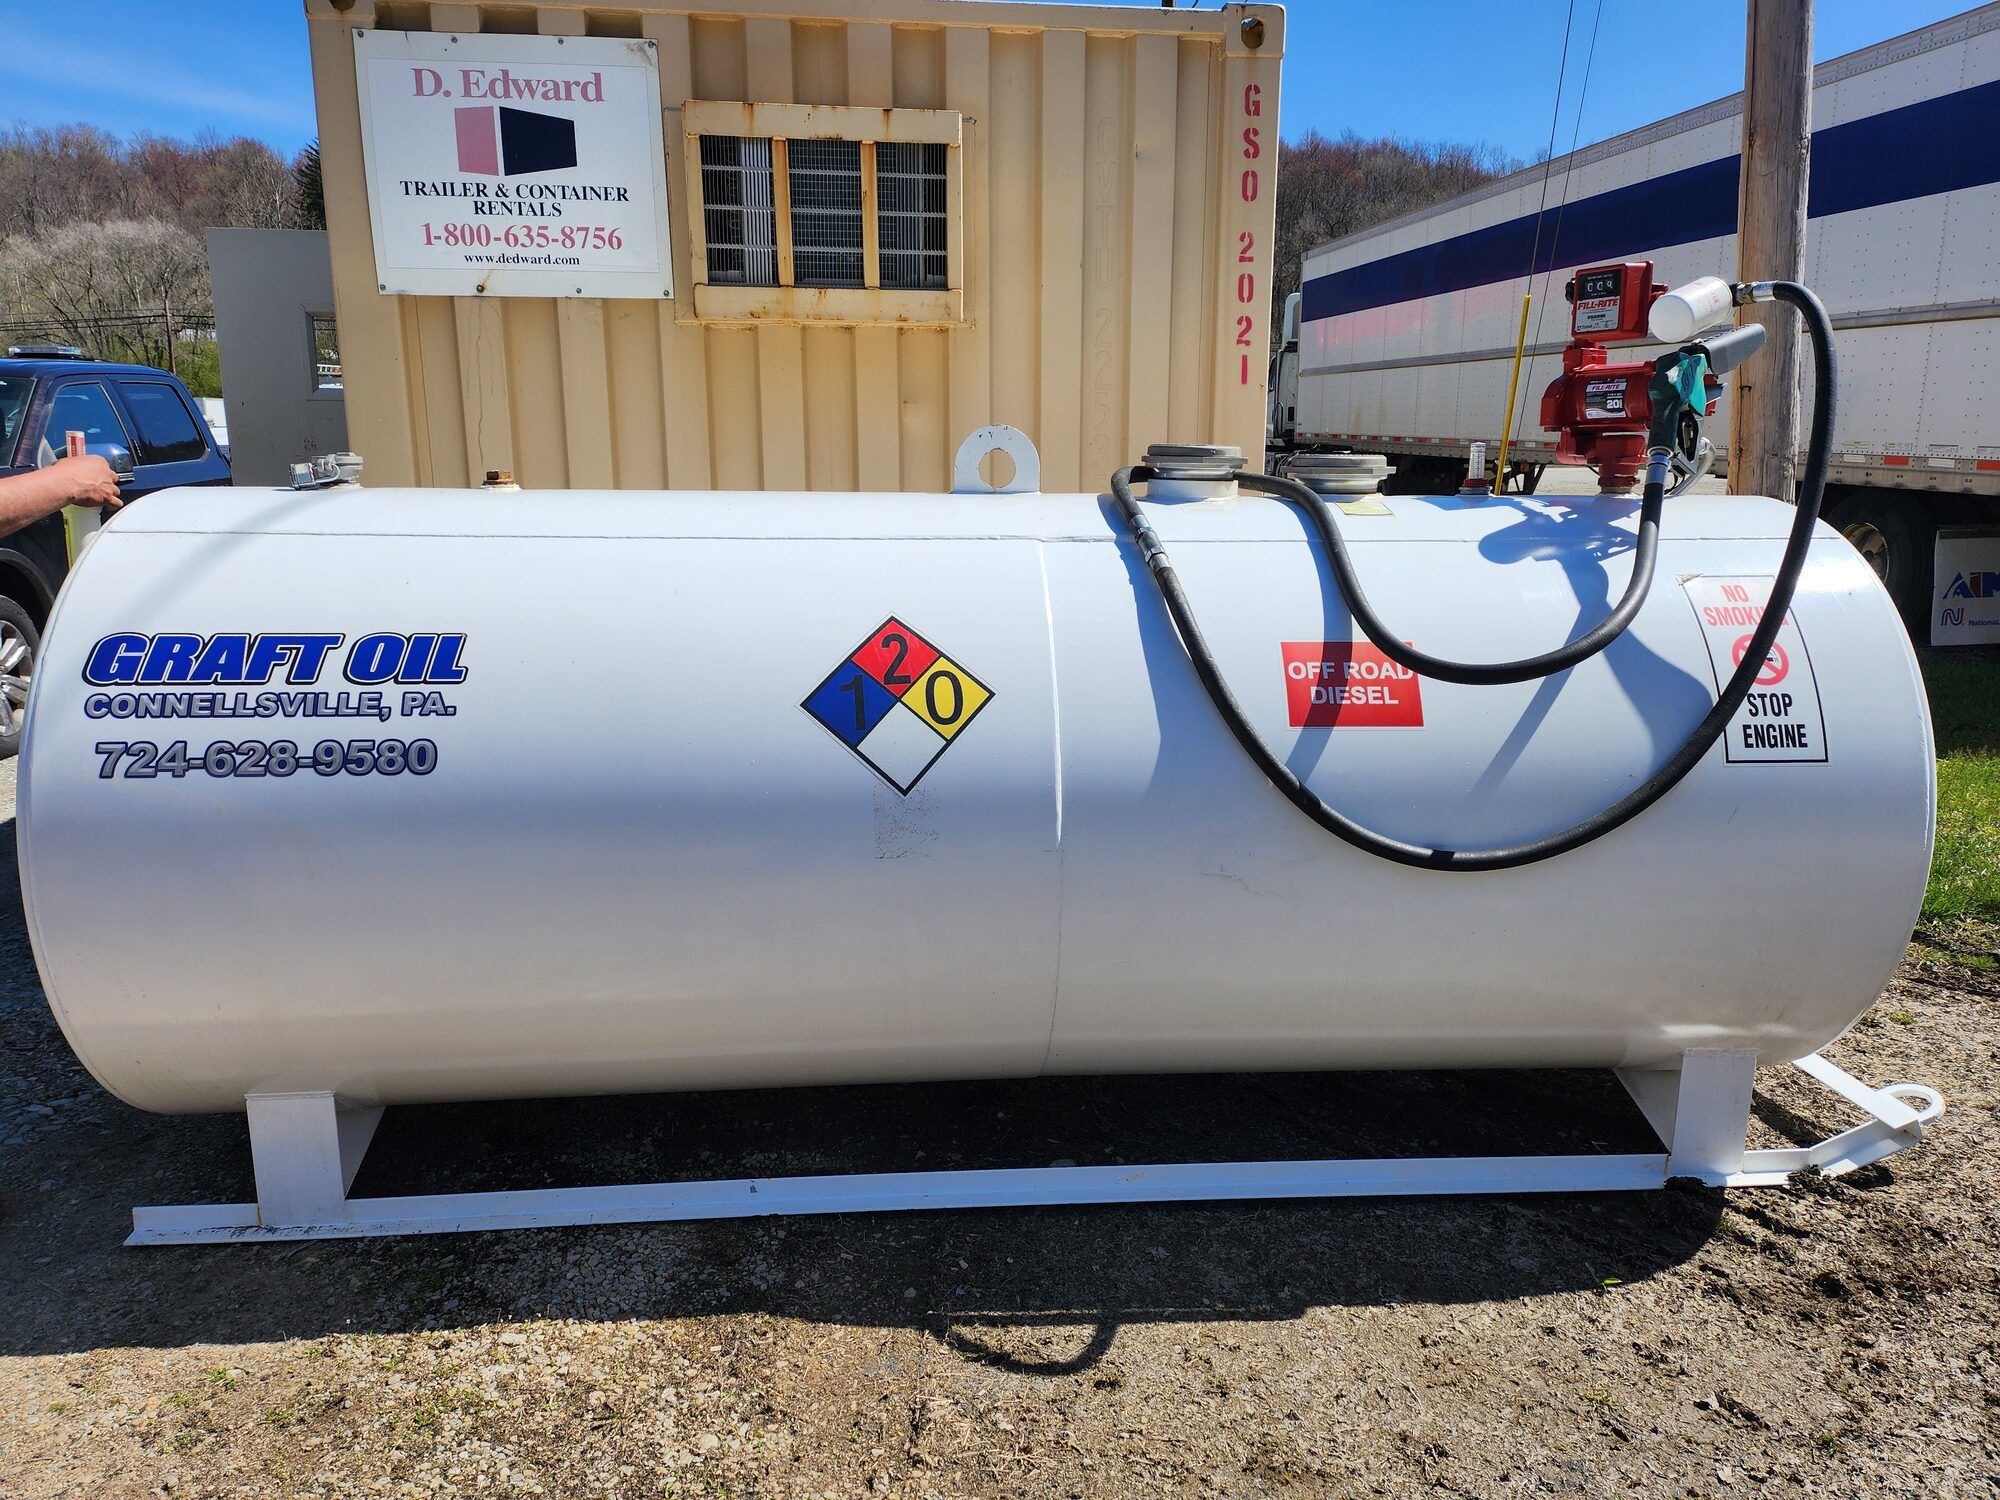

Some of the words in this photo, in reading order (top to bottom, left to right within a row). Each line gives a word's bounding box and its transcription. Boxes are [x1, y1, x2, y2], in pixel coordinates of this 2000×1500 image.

[410, 67, 451, 98] D.
[458, 68, 605, 102] Edward
[400, 180, 489, 198] TRAILER
[494, 183, 510, 198] &
[515, 184, 630, 202] CONTAINER
[473, 201, 562, 217] RENTALS
[421, 222, 622, 250] 1-800-635-8756
[464, 253, 580, 266] www.dedward.com
[1577, 298, 1619, 311] FILL-RITE
[1720, 584, 1750, 603] NO
[1703, 606, 1790, 627] SMOKI
[81, 632, 345, 686] GRAFT
[342, 632, 469, 685] OIL
[881, 633, 911, 685] 2
[1288, 661, 1335, 680] OFF
[1343, 661, 1413, 680] ROAD
[84, 691, 391, 722] CONNELLSVILLE,
[401, 691, 457, 716] PA.
[839, 674, 866, 731] 1
[925, 670, 963, 726] 0
[1310, 685, 1399, 704] DIESEL
[1746, 692, 1793, 717] STOP
[1742, 723, 1808, 749] ENGINE
[95, 739, 438, 779] 724-628-9580
